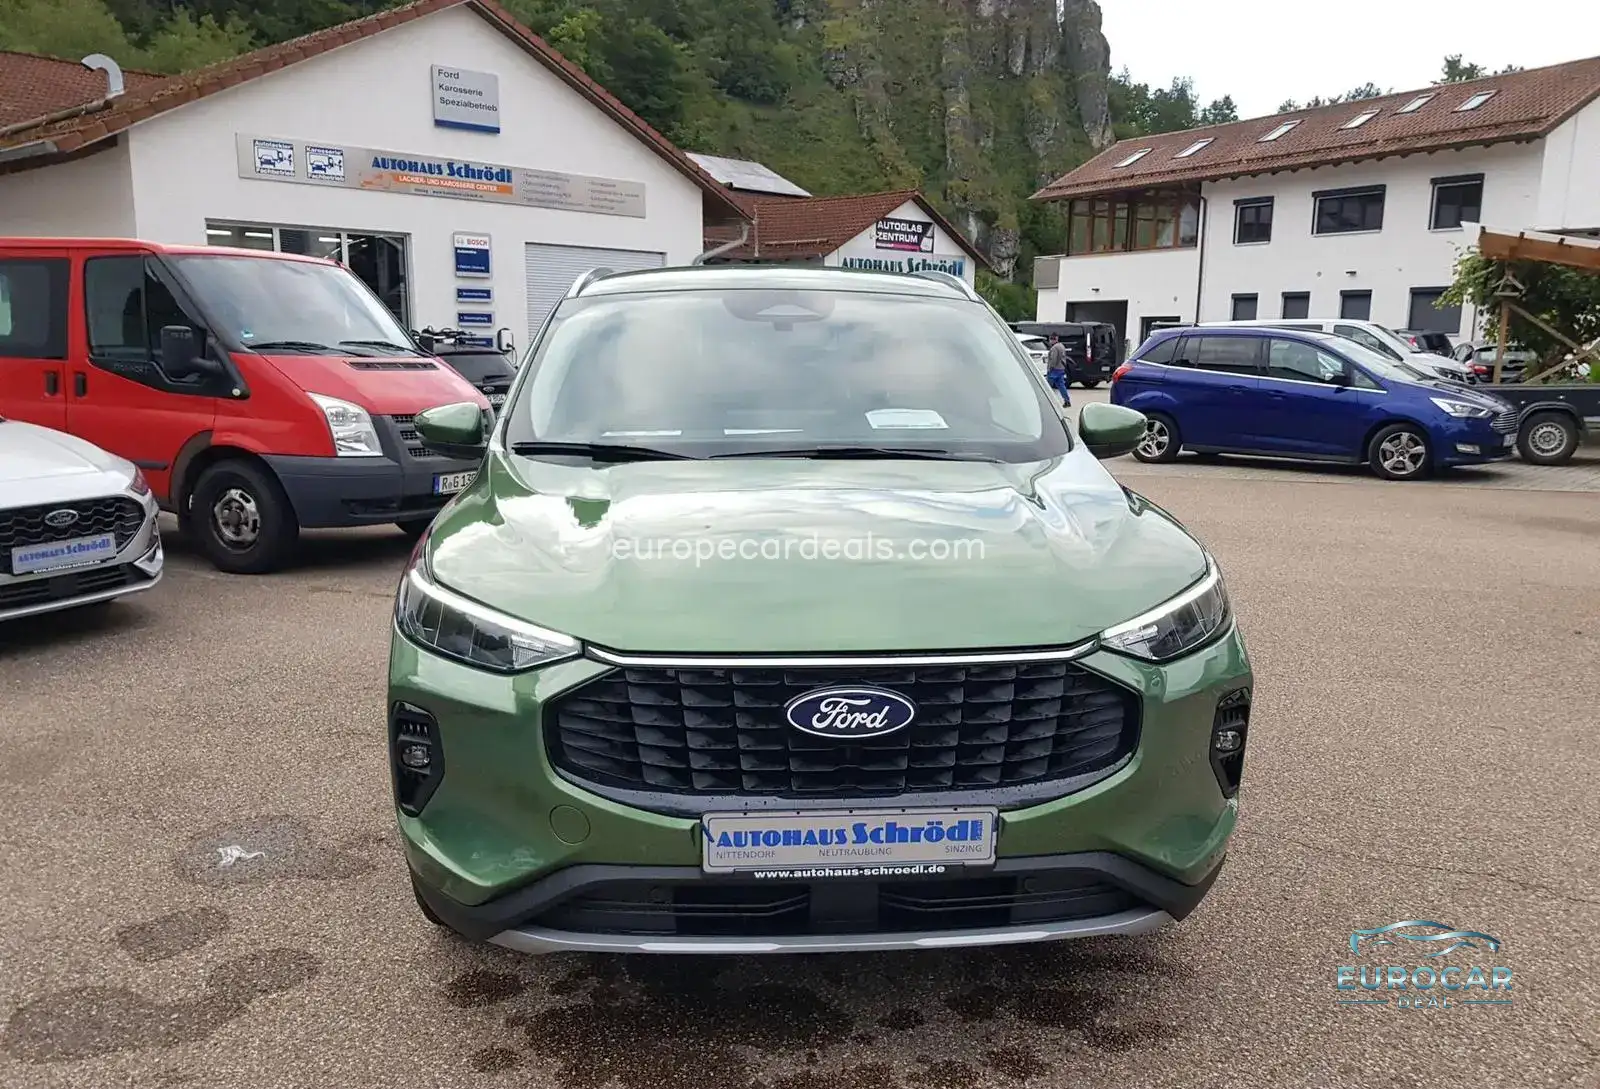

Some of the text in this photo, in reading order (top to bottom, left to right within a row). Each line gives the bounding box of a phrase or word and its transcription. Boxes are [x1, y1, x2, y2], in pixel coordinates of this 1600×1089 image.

[437, 68, 460, 80] Ford
[438, 82, 483, 97] Karosserie
[439, 96, 498, 112] Spezialbetrieb
[372, 156, 443, 176] AUTOHAUS
[446, 161, 513, 184] Schrödl
[426, 178, 440, 186] UND
[475, 183, 498, 192] CENTER
[877, 220, 923, 233] AUTOGLAS
[466, 238, 488, 247] BOSCH
[876, 231, 918, 243] ZENTRUM
[842, 256, 903, 273] AUTOHAUS
[453, 475, 459, 488] G
[811, 697, 890, 729] Ford
[716, 828, 848, 848] AUTOHAUS
[852, 819, 983, 845] Schrödl
[715, 844, 983, 860] NITTENDORF NEUTRAUBLING SINZING
[754, 864, 945, 879] www.autohaus-schroedl.de
